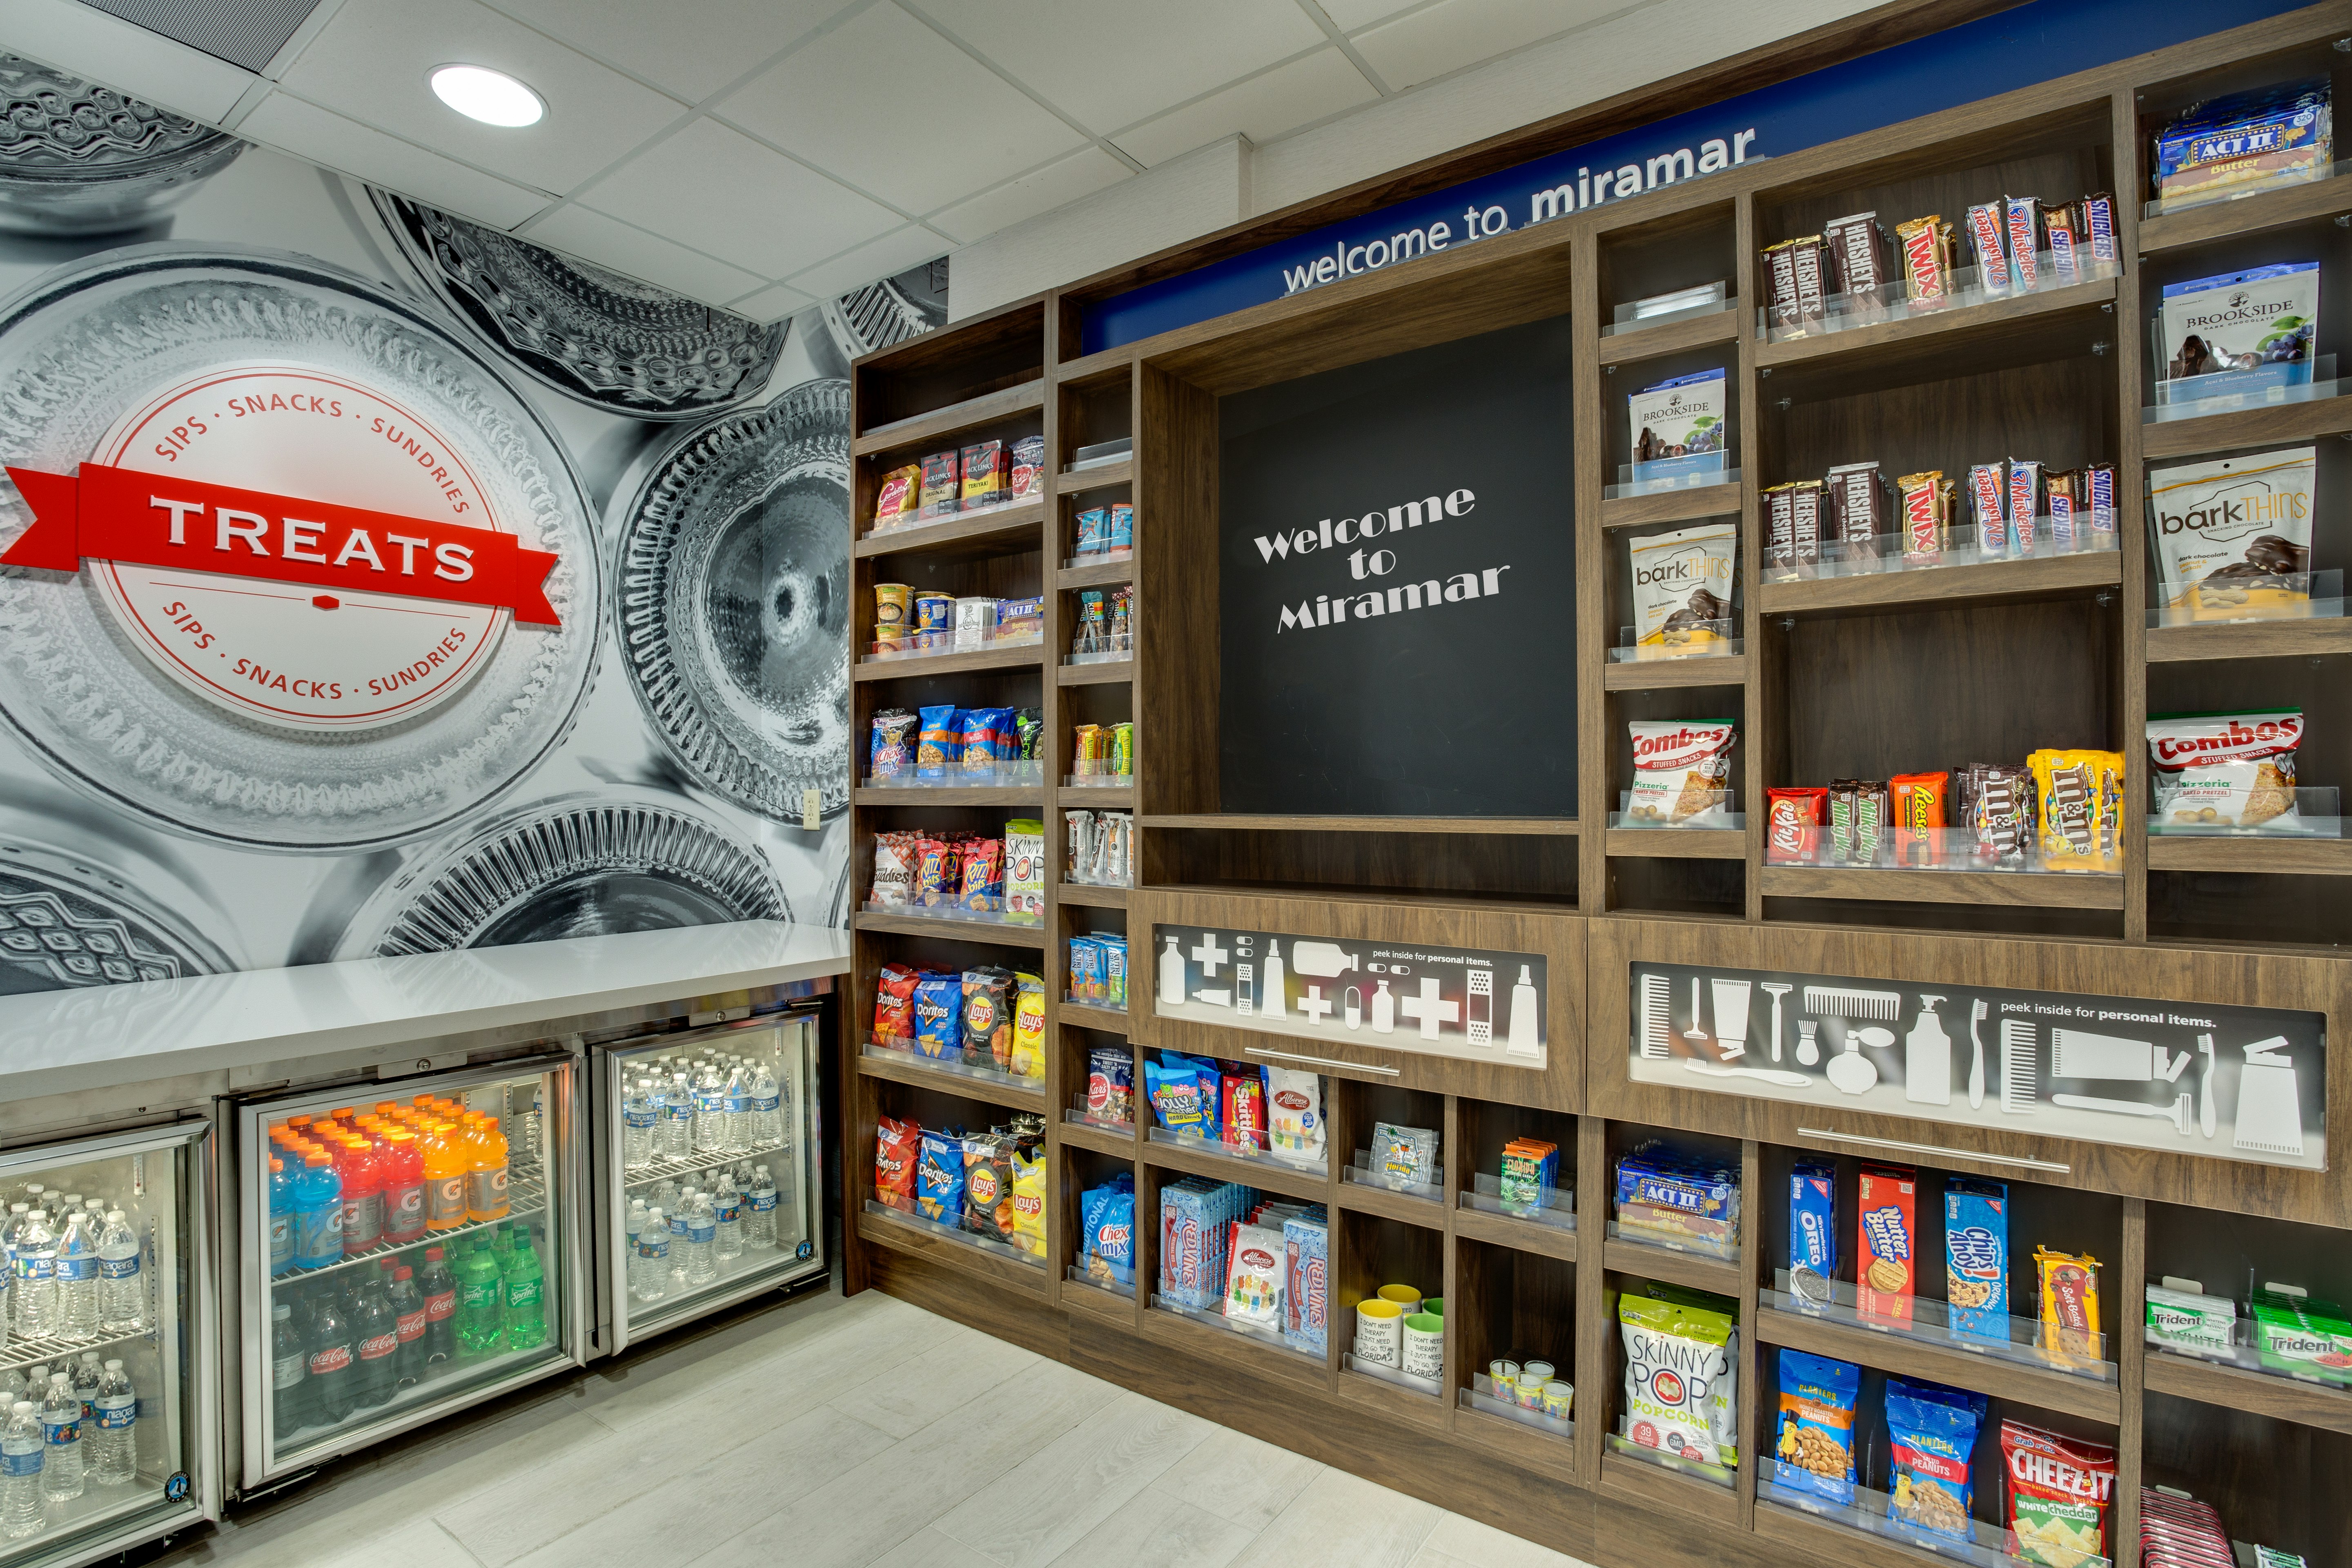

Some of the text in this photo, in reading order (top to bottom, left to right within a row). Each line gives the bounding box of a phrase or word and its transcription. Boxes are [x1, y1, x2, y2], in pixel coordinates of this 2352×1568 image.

[2296, 114, 2312, 122] 320
[2201, 137, 2245, 158] ACT
[2247, 132, 2273, 149] II
[2210, 158, 2261, 175] Butter
[1283, 128, 1755, 293] welcome to miramar
[2091, 200, 2113, 260] SNICKERS
[2007, 209, 2037, 290] 3 Musketeers
[1845, 223, 1875, 294] HERSHEY'S
[1772, 252, 1798, 317] HERSHEY'S
[2186, 301, 2293, 328] BROOKSIDE
[2228, 316, 2274, 326] CHOCOLATE
[1643, 403, 1708, 421] BROOKSIDE
[156, 394, 470, 514] SIPS SNACKS SUNDRIES
[968, 481, 989, 489] TERIYAKI
[1846, 473, 1872, 542] HERSHEY'S
[2093, 470, 2111, 531] SNICKERS
[2010, 471, 2034, 554] 3 Musketeers
[1254, 489, 1475, 564] Welcome
[2207, 525, 2232, 533] SNACKING
[150, 494, 474, 581] TREATS
[1347, 548, 1396, 580] to
[1277, 565, 1510, 633] Miramar
[164, 601, 465, 699] SIPS SNACKS SUNDRIES
[2158, 718, 2298, 760] Combos
[879, 746, 899, 762] Chex
[1022, 725, 1035, 777] PISTACHIOS
[1678, 753, 1701, 764] SNACKS
[2201, 748, 2274, 764] STUFFED SNACKS
[880, 760, 898, 774] mix
[1635, 781, 1667, 790] Pizzeria
[1914, 786, 1934, 841] Reese's
[921, 853, 941, 875] RITZ
[965, 860, 989, 881] RITZ
[923, 875, 941, 887] bits
[968, 880, 987, 894] bits
[1392, 951, 1413, 959] inside
[1428, 955, 1463, 964] personal
[1466, 957, 1492, 966] items.
[878, 992, 903, 1007] Doritos
[917, 1004, 949, 1018] Doritos
[970, 1007, 992, 1023] Lay's
[2001, 1002, 2217, 1028] peek inside for personal items.
[1089, 1082, 1107, 1096] Kar's
[1158, 1096, 1189, 1108] JOLLY
[1276, 1093, 1307, 1105] Albanese
[630, 1113, 655, 1123] niagara
[1236, 1087, 1250, 1151] Skittles
[919, 1163, 953, 1184] Doritos
[1386, 1162, 1410, 1174] Florida
[1507, 1158, 1535, 1174] FLORIDA
[443, 1180, 462, 1200] G
[971, 1176, 996, 1196] Lay's
[1015, 1194, 1040, 1214] Lay's
[1646, 1186, 1697, 1207] ACT II
[975, 1205, 991, 1213] Barbecue
[1653, 1208, 1687, 1223] Butter
[1020, 1223, 1038, 1231] Classic
[1100, 1226, 1129, 1241] Chex
[1881, 1207, 1909, 1258] Nutter
[1801, 1211, 1820, 1265] OREO
[1102, 1240, 1129, 1256] mix
[1965, 1228, 1996, 1270] Chips
[1243, 1252, 1273, 1264] Albanese
[100, 1260, 134, 1273] niagara
[512, 1289, 534, 1300] Sprite
[2152, 1314, 2203, 1326] Trident
[1365, 1328, 1386, 1336] THERAPY
[1654, 1326, 1675, 1334] POPPED
[1677, 1331, 1709, 1342] PERFECTION
[1416, 1344, 1438, 1352] THERAPY
[2267, 1336, 2338, 1352] Trident
[310, 1343, 352, 1367] Coca-Cola
[1358, 1348, 1388, 1362] FLORIDA
[1407, 1364, 1439, 1378] FLORIDA
[1632, 1361, 1707, 1413] POP
[1799, 1384, 1836, 1401] PLANTERS
[1633, 1398, 1709, 1430] POPCORN
[1801, 1410, 1830, 1423] PEANUTS
[1814, 1407, 1833, 1417] ROASTED
[1638, 1434, 1654, 1443] CALORIES
[1641, 1425, 1651, 1437] 39
[1670, 1438, 1683, 1448] GMO
[1911, 1434, 1953, 1454] PLANTERS
[1686, 1448, 1699, 1456] GLUTEN
[1922, 1455, 1940, 1464] SALTED
[1912, 1458, 1950, 1476] PEANUTS
[2049, 1504, 2096, 1519] cheddar
